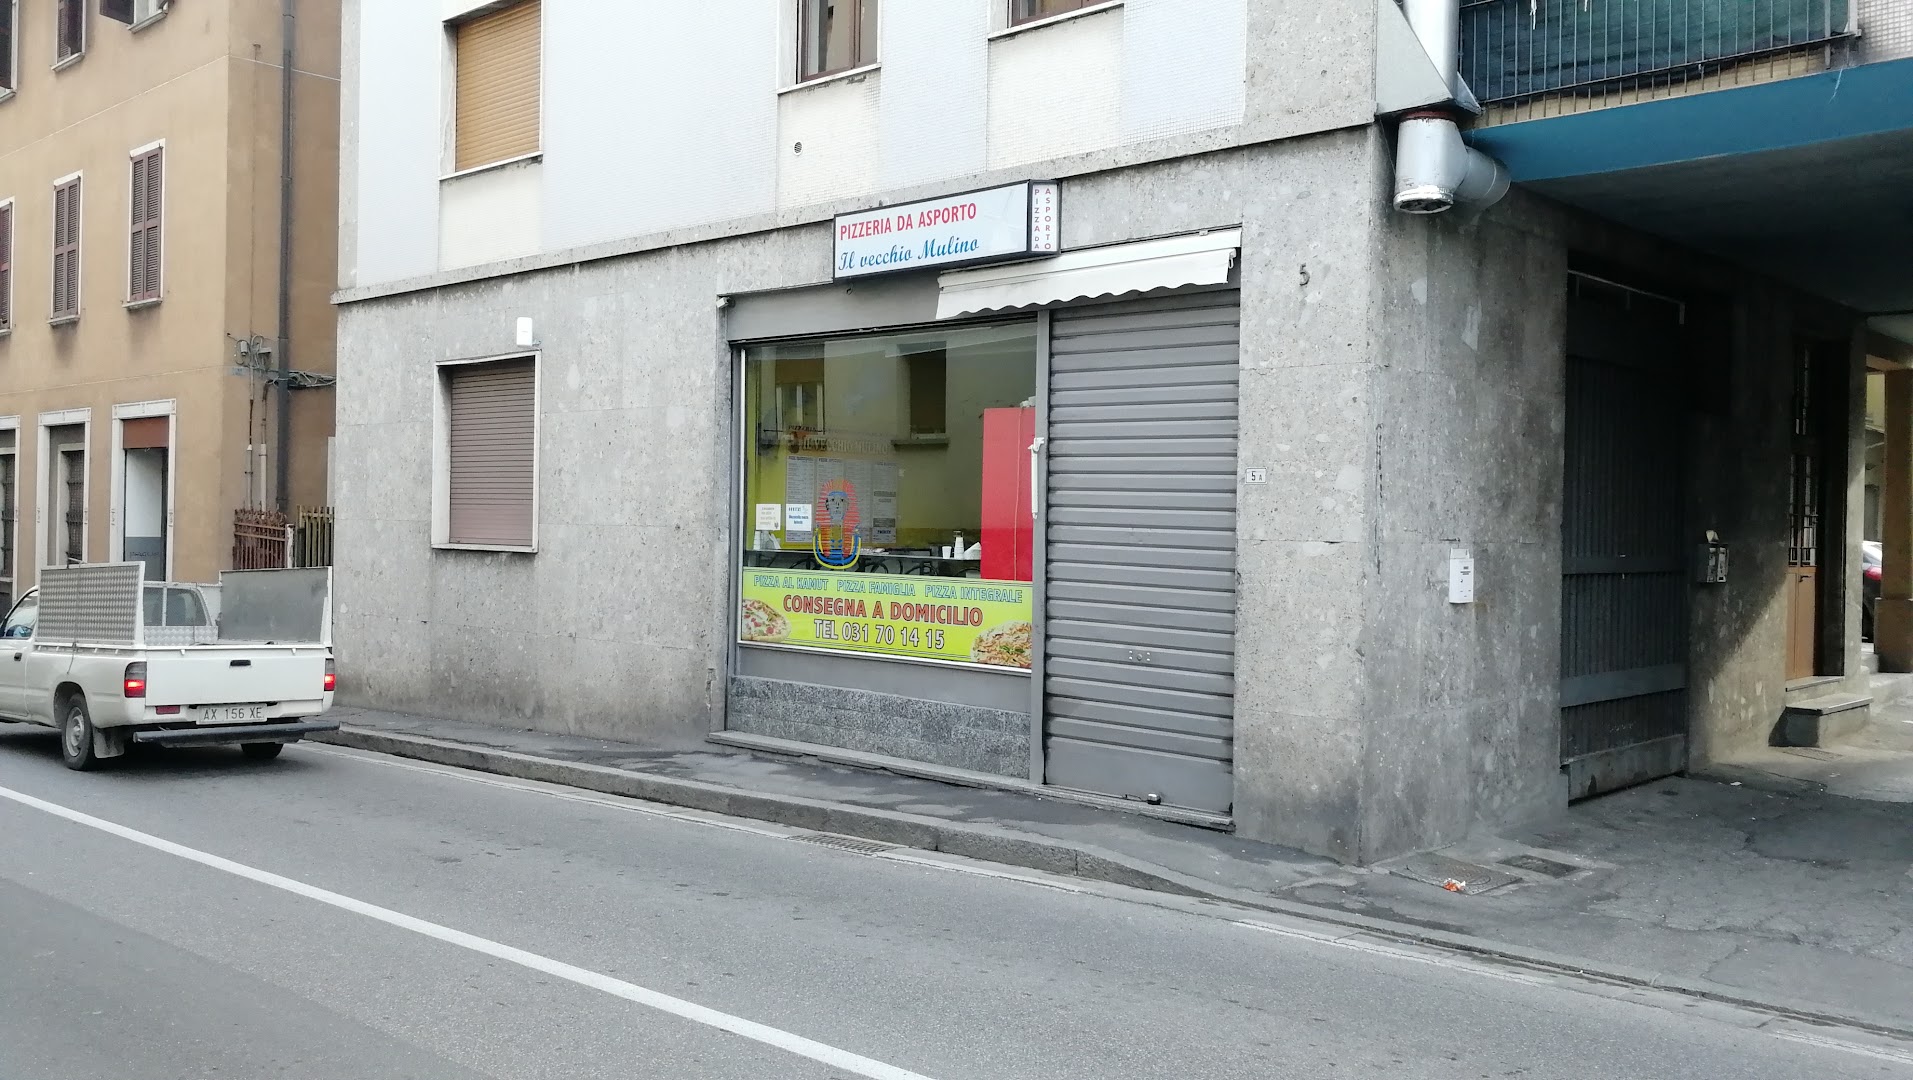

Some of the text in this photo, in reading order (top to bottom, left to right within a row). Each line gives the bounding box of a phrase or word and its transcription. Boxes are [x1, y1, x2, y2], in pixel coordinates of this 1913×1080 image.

[840, 202, 977, 241] PIZZERIA DA ASPORTO
[1044, 187, 1052, 250] ASPORTO
[838, 235, 979, 271] Il vecchio Mulino
[1034, 236, 1040, 249] DA
[1299, 263, 1310, 286] 5
[1251, 471, 1256, 481] 5
[753, 574, 1023, 604] PIZZA AL KAMUT PIZZA FAMIGLIA PIZZA INTEGRALE
[783, 594, 984, 627] CONSEGNA A DOMICILIO
[814, 619, 945, 650] TEL 031 70 14 15
[203, 707, 263, 721] AX 156 XE
